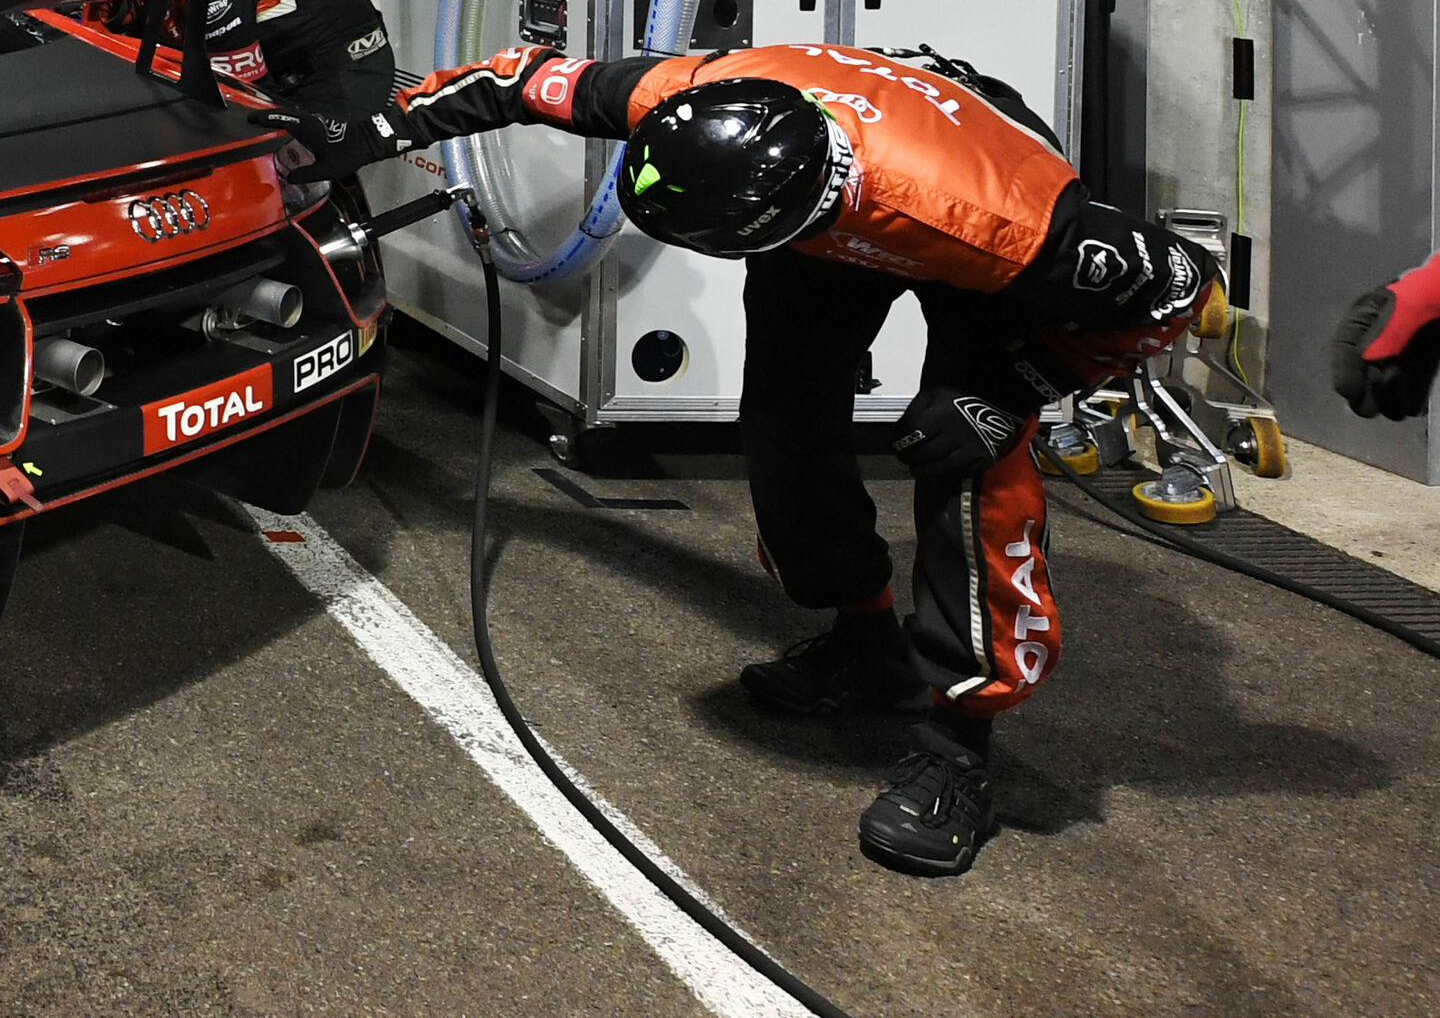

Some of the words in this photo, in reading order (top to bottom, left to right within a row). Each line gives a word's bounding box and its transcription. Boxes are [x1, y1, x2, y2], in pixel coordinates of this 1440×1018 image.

[205, 17, 242, 40] nap-on
[737, 205, 782, 237] uvex
[296, 333, 352, 388] PRO
[158, 386, 263, 442] TOTAL
[1005, 519, 1050, 693] OTAL
